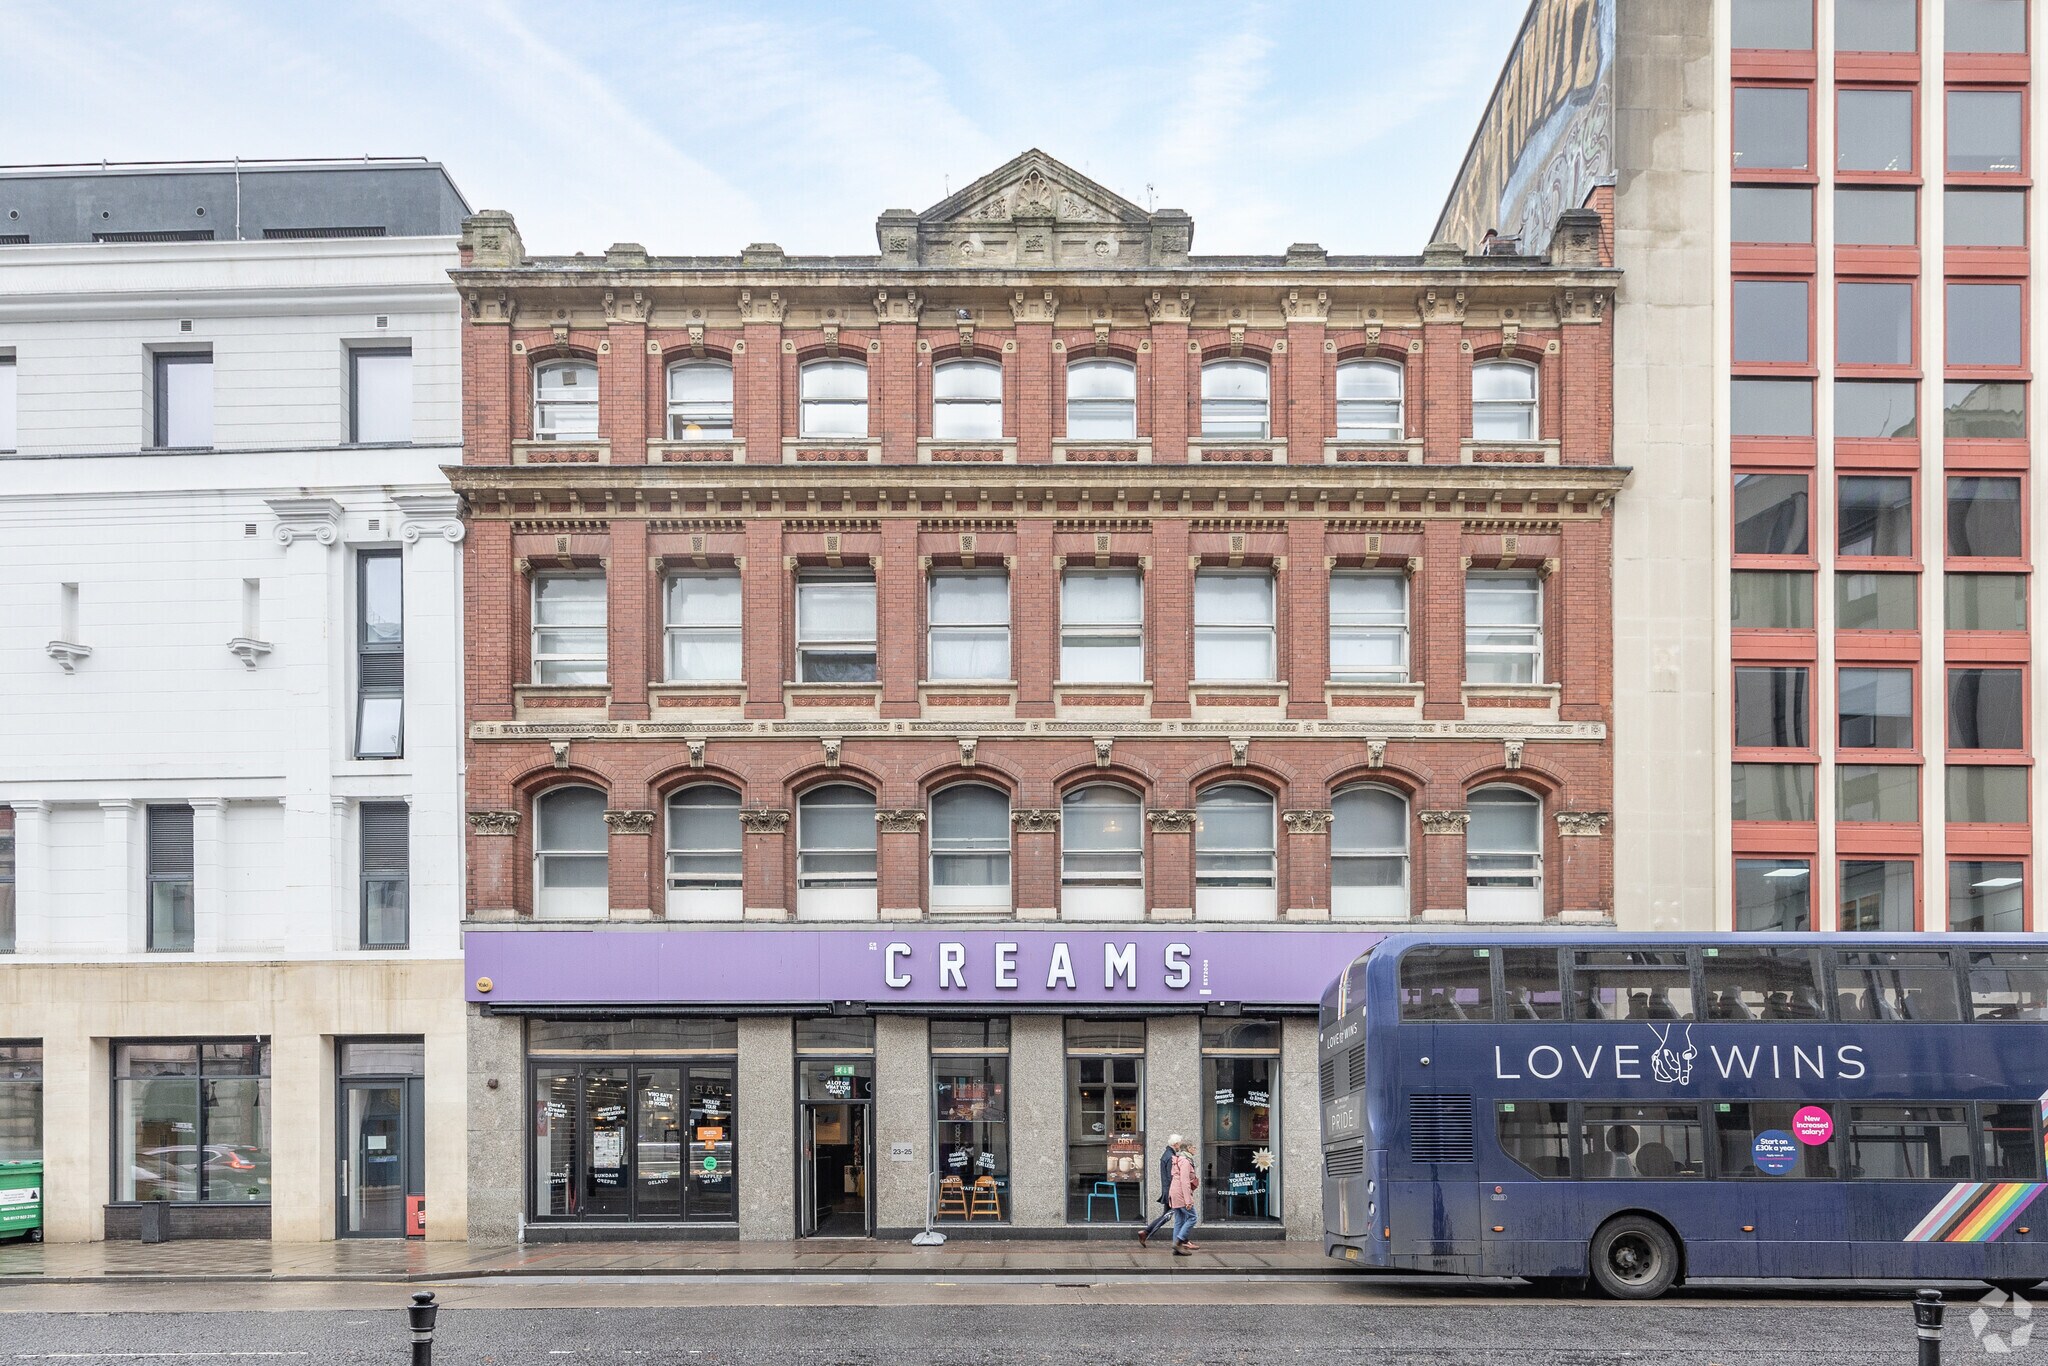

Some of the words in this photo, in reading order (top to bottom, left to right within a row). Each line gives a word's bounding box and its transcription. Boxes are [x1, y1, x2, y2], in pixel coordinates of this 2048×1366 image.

[885, 942, 1191, 988] CREAMS
[1327, 1032, 1340, 1049] LOVE
[1344, 1022, 1358, 1040] WINS
[1495, 1045, 1641, 1079] LOVE
[1710, 1045, 1866, 1079] WINS
[1331, 1109, 1354, 1132] PRIDE
[984, 1162, 996, 1170] LESS
[648, 1178, 669, 1186] GELATO
[1245, 1188, 1266, 1196] GELATO
